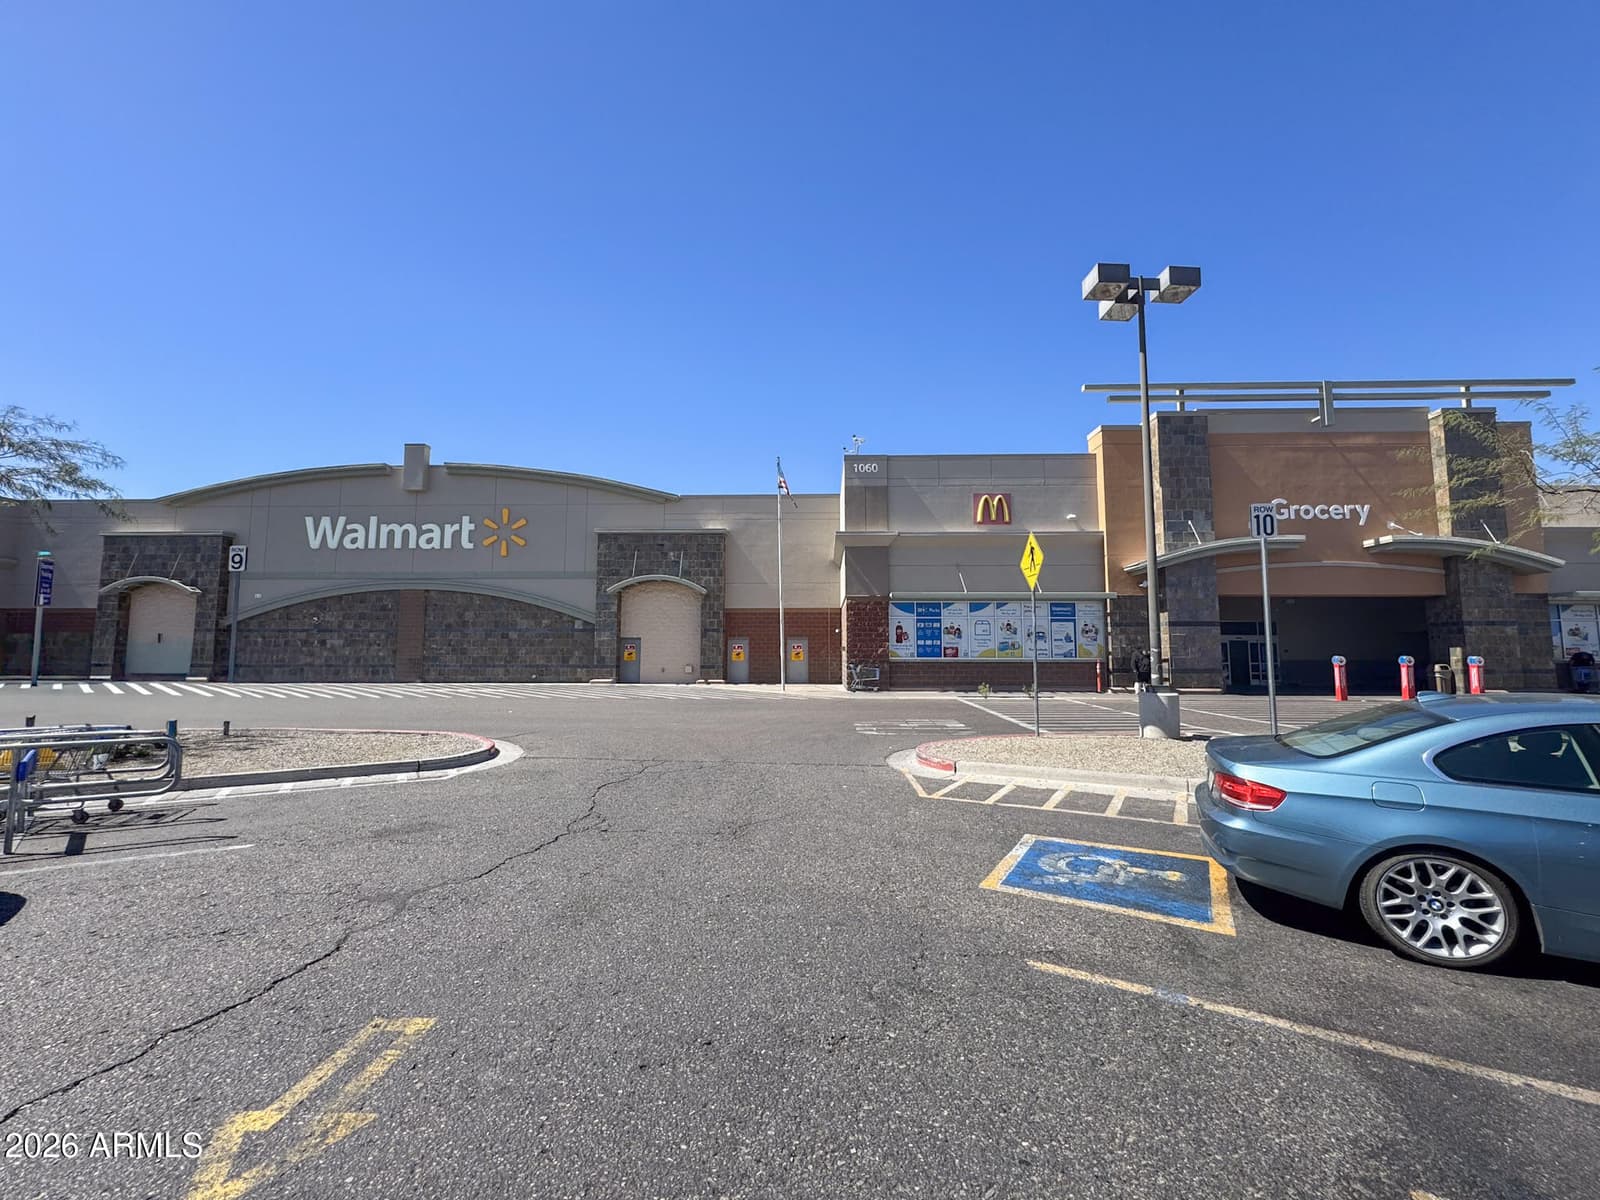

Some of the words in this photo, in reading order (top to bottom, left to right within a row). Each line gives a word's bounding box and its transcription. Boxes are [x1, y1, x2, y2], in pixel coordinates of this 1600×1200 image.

[853, 463, 879, 473] 1060
[1271, 498, 1370, 526] Grocery
[304, 515, 475, 549] Walmart
[1254, 514, 1275, 536] 10
[231, 553, 243, 570] 9
